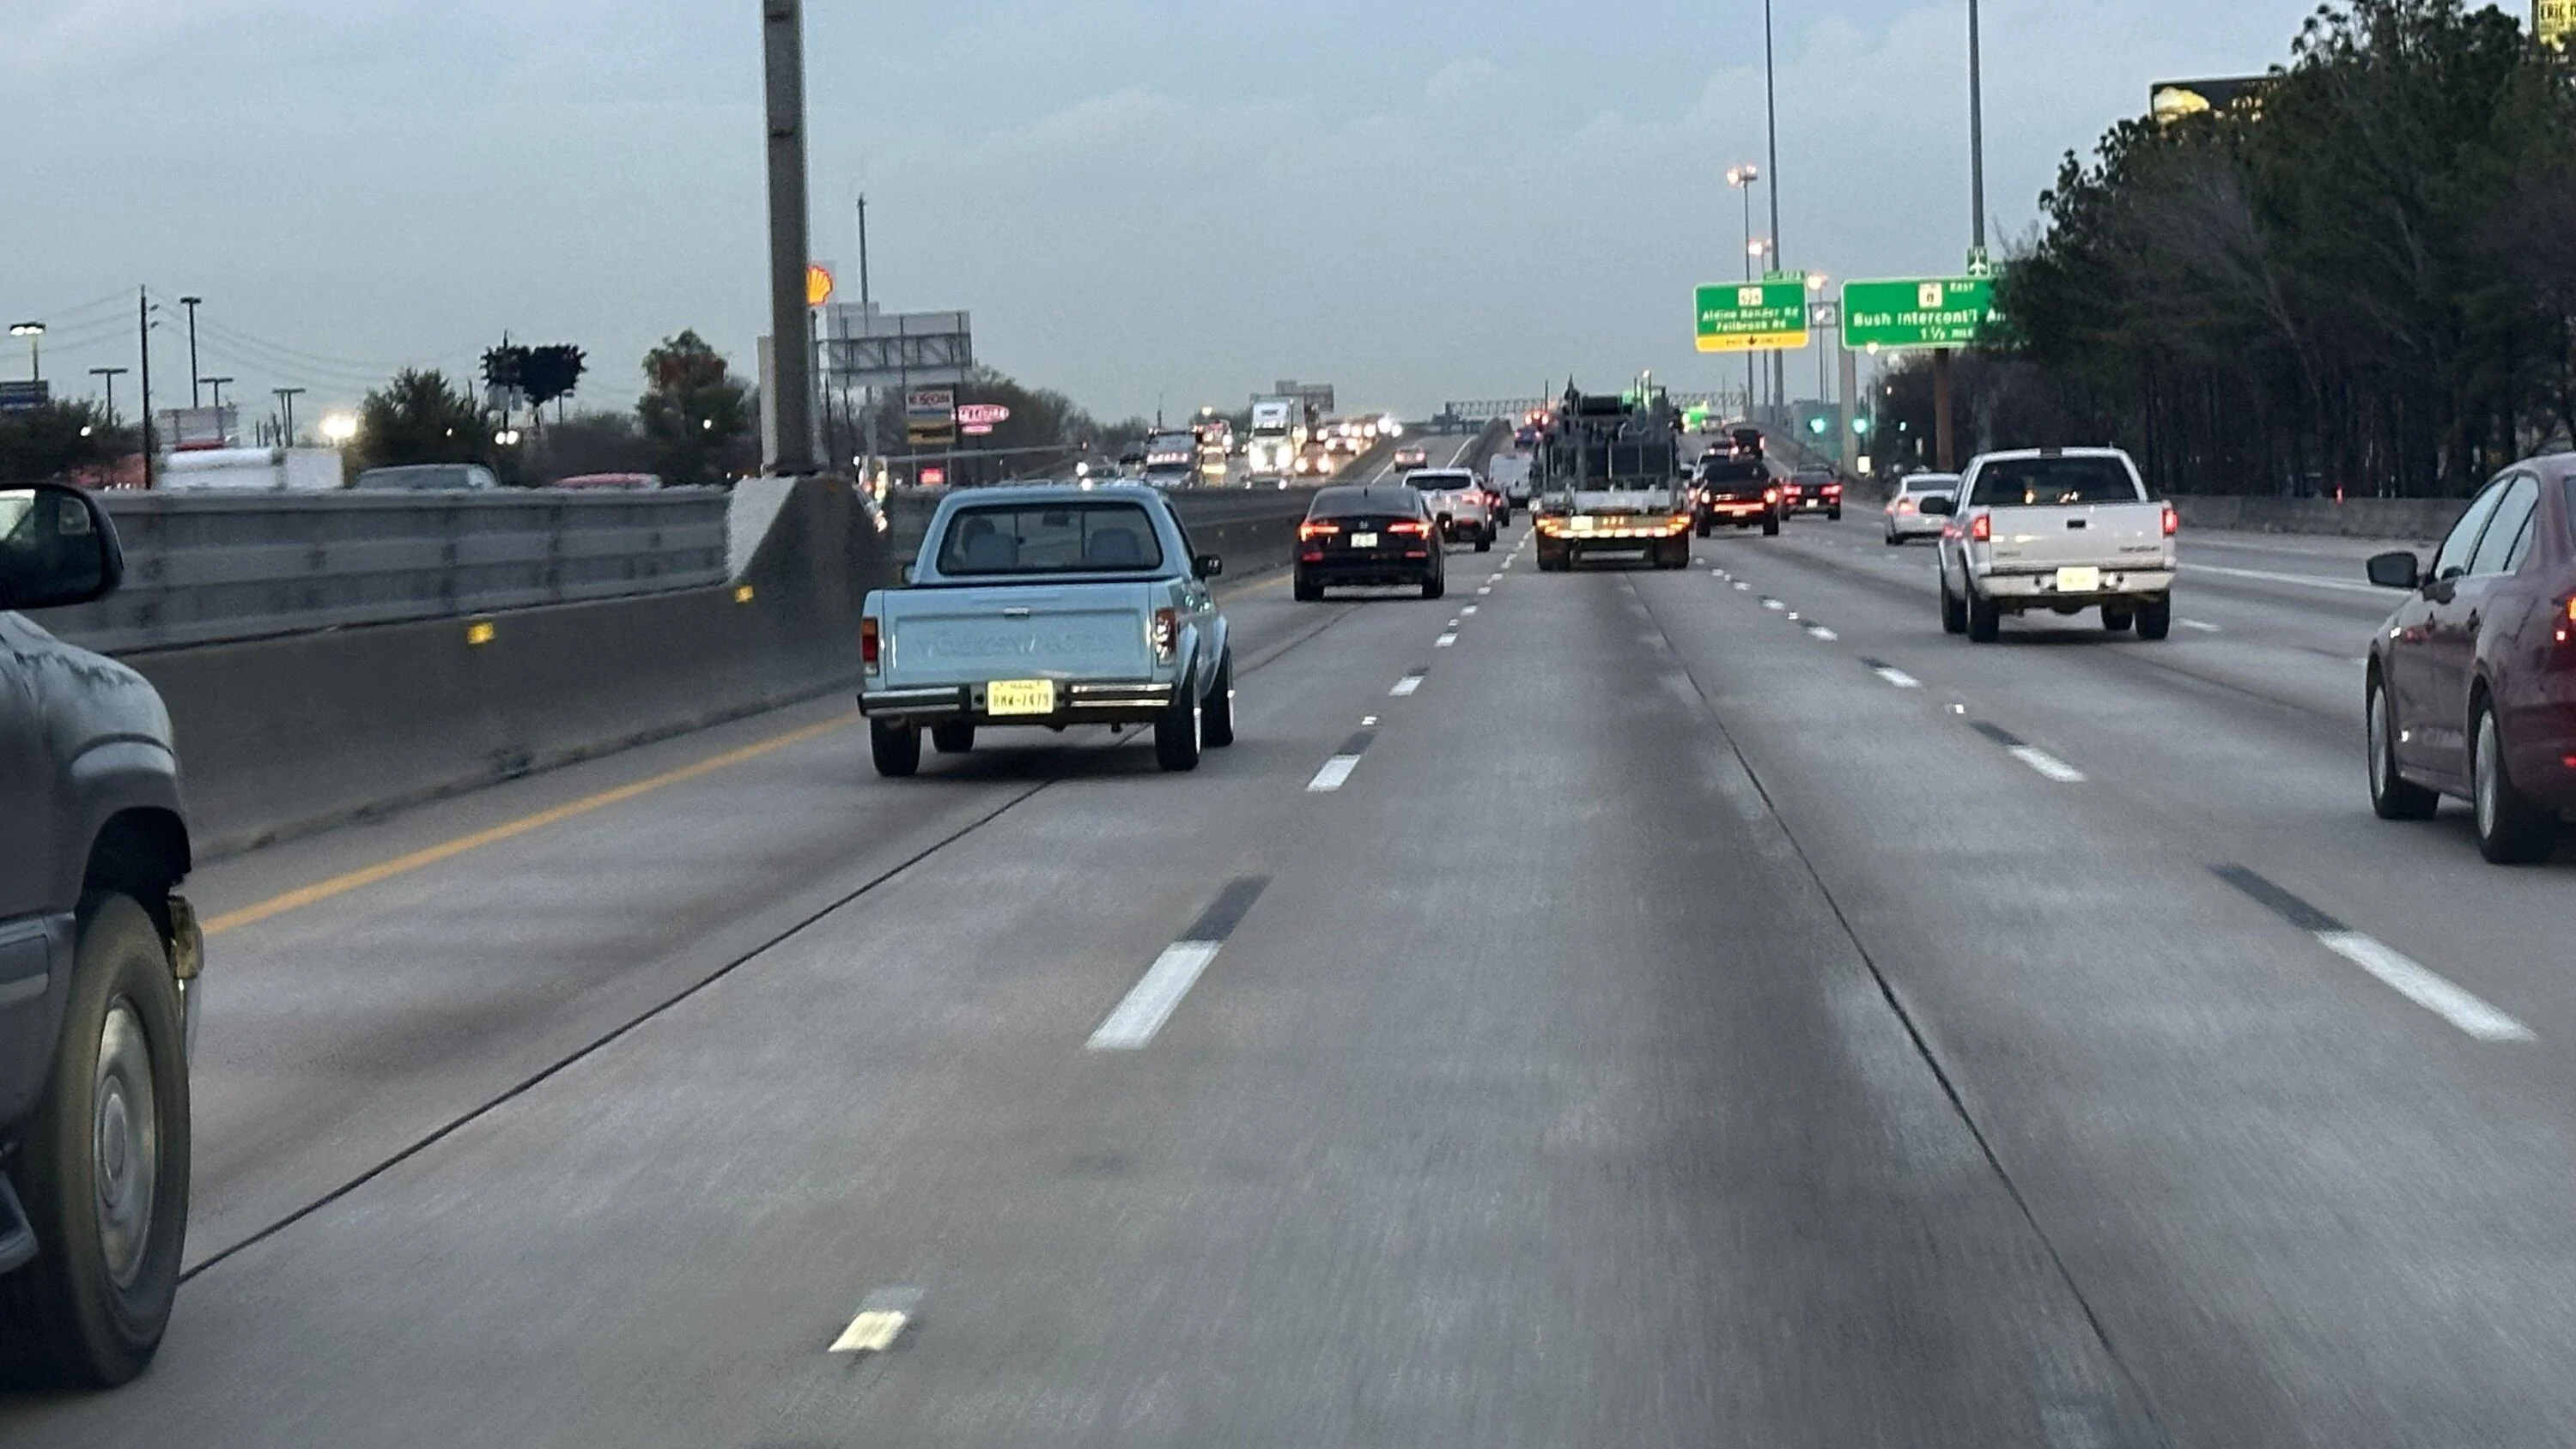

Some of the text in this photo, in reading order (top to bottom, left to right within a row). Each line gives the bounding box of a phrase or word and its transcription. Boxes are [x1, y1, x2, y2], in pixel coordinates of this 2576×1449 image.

[1852, 311, 1892, 327] Bush
[1897, 308, 1978, 325] Intercont'l
[1920, 327, 1928, 341] 1
